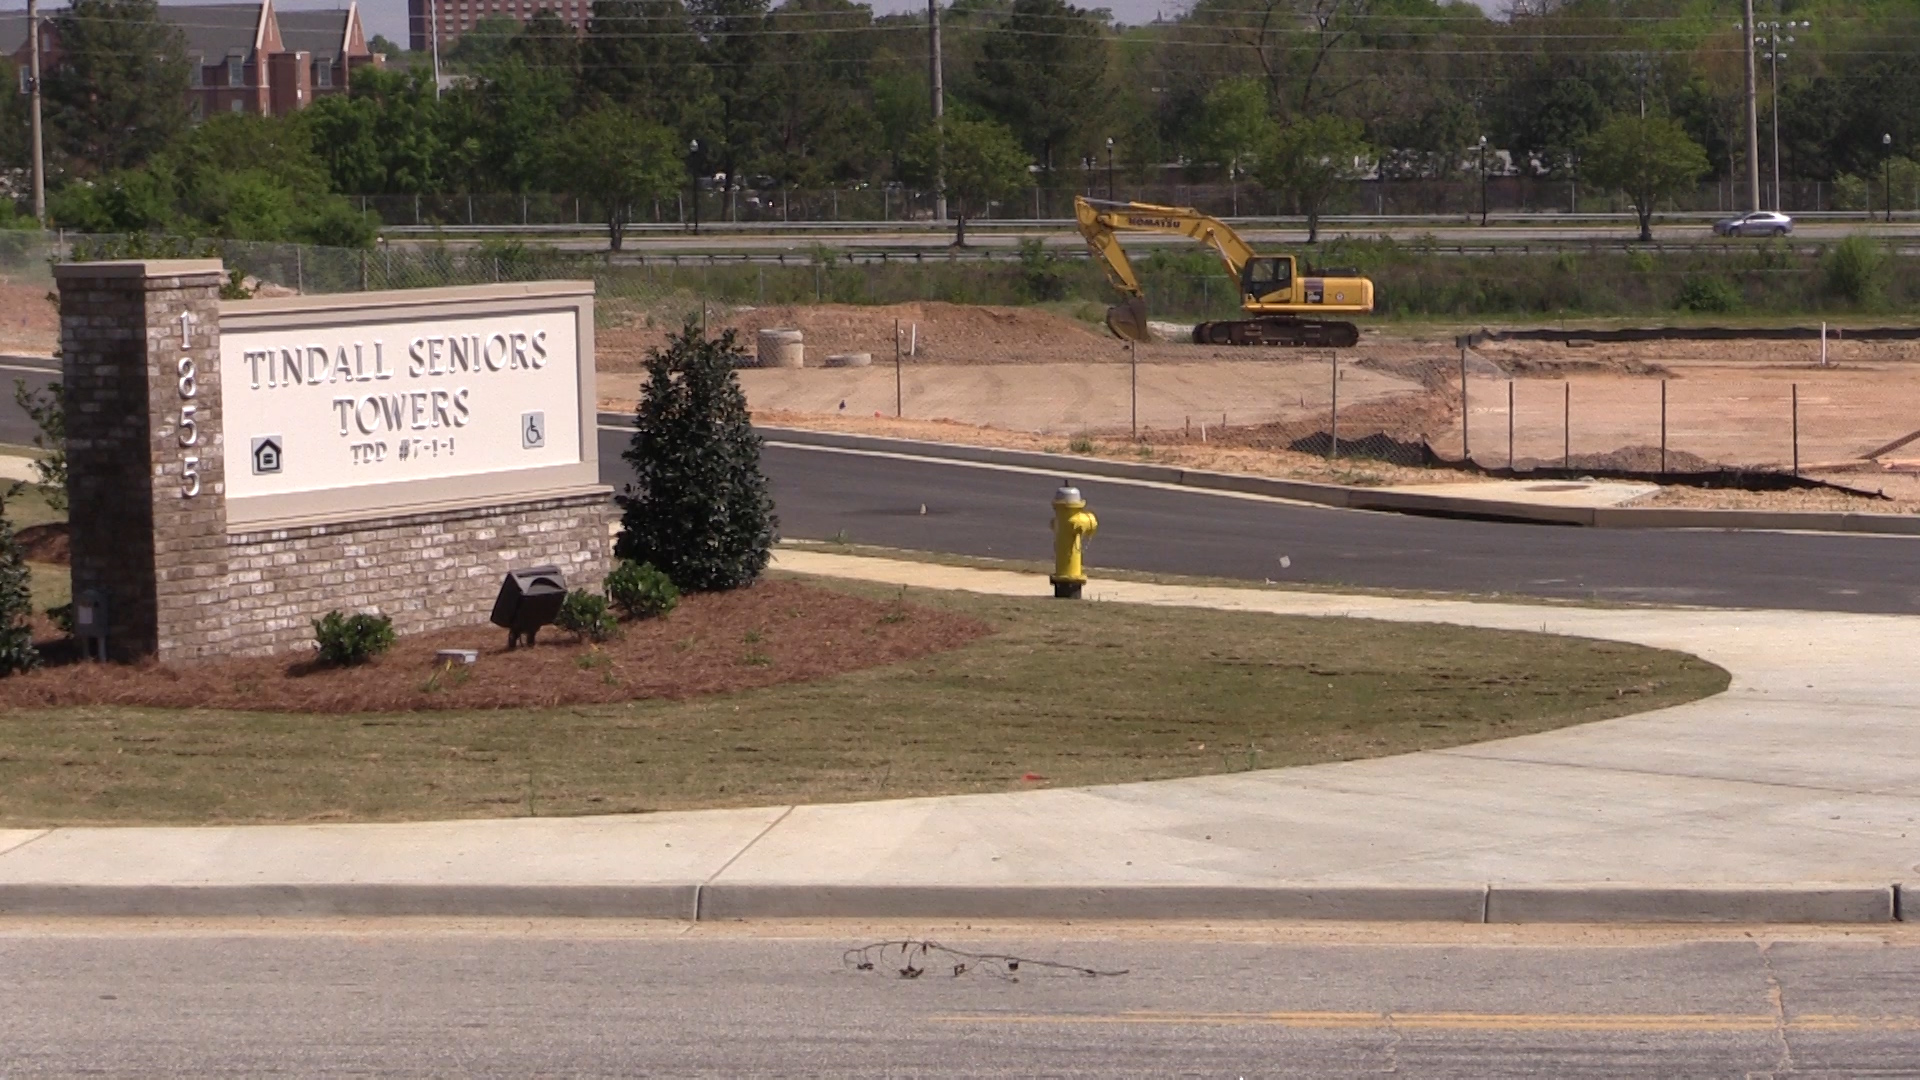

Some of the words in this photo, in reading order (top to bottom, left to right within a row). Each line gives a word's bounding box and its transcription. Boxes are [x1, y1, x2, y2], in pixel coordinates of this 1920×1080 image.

[1128, 216, 1181, 228] KOMATSU
[243, 338, 395, 389] TINDALL
[408, 329, 548, 378] SENIORS
[177, 310, 200, 498] 1855
[333, 386, 470, 436] TOWERS
[350, 440, 388, 465] TDD
